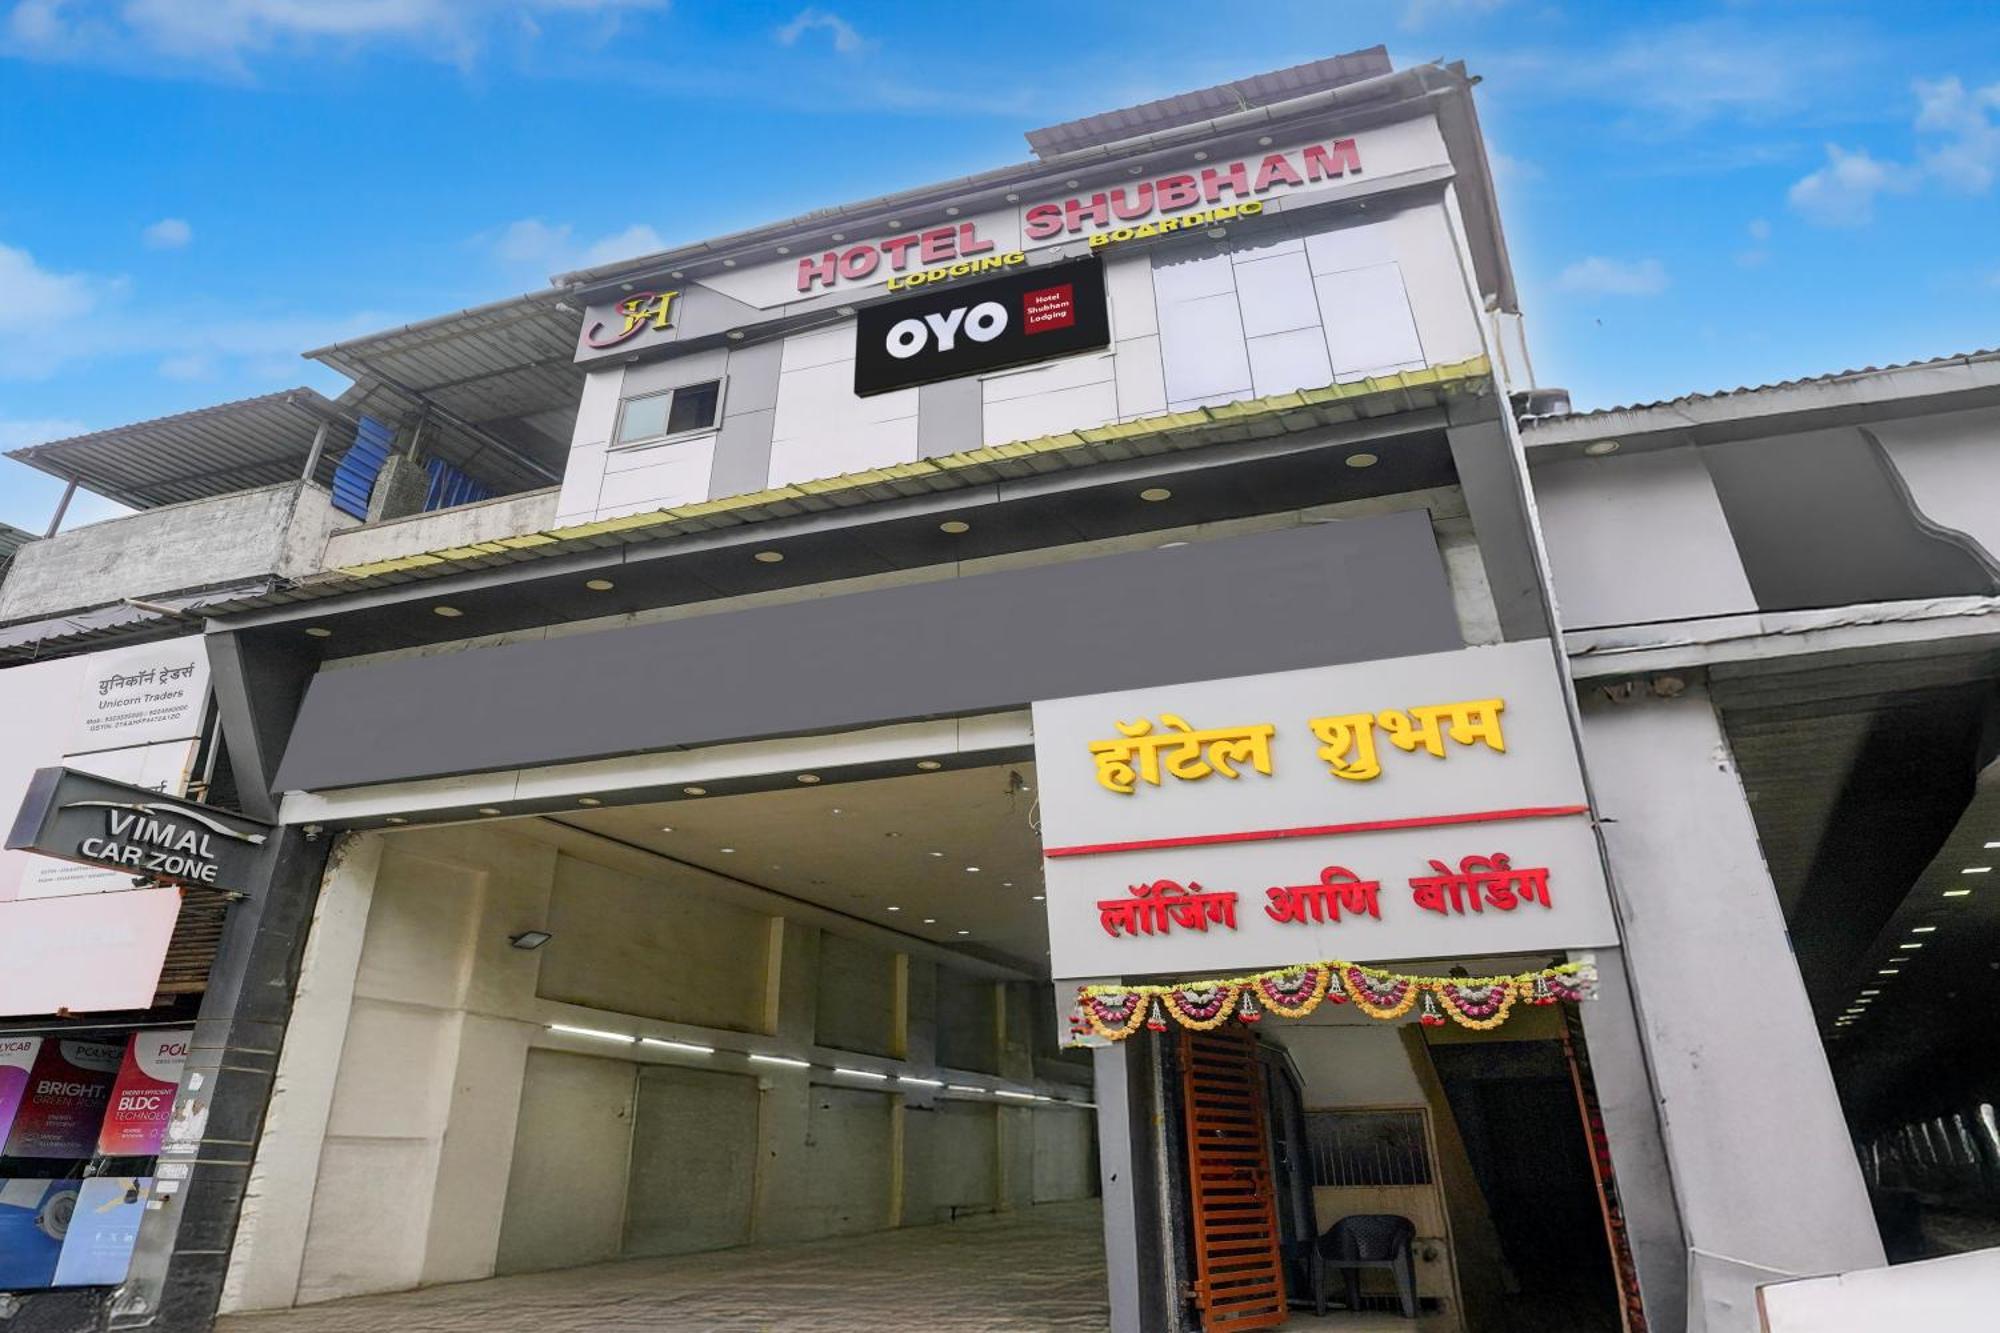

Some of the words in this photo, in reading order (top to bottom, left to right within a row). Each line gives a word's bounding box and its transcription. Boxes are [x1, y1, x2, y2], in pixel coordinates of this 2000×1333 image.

[797, 222, 994, 292] HOTEL
[1024, 139, 1362, 240] SHUBHAM
[887, 252, 1025, 292] LODGING
[1088, 201, 1264, 249] BOARDING
[1027, 300, 1070, 314] Shubham
[1030, 310, 1067, 323] Lodging
[1035, 292, 1060, 303] Hotel
[886, 301, 1008, 359] OYO
[98, 697, 141, 709] Unicorn
[144, 689, 184, 703] Traders
[1089, 714, 1275, 794] हॉटेल
[1309, 699, 1505, 782] शुभम
[109, 809, 215, 859] VIMAL
[81, 838, 143, 865] CAR
[146, 851, 218, 882] ZONE
[1097, 879, 1240, 938] लॉजिंग
[1264, 866, 1382, 925] आणि
[1409, 852, 1552, 915] बोर्डिंग
[118, 1096, 161, 1111] BLDC
